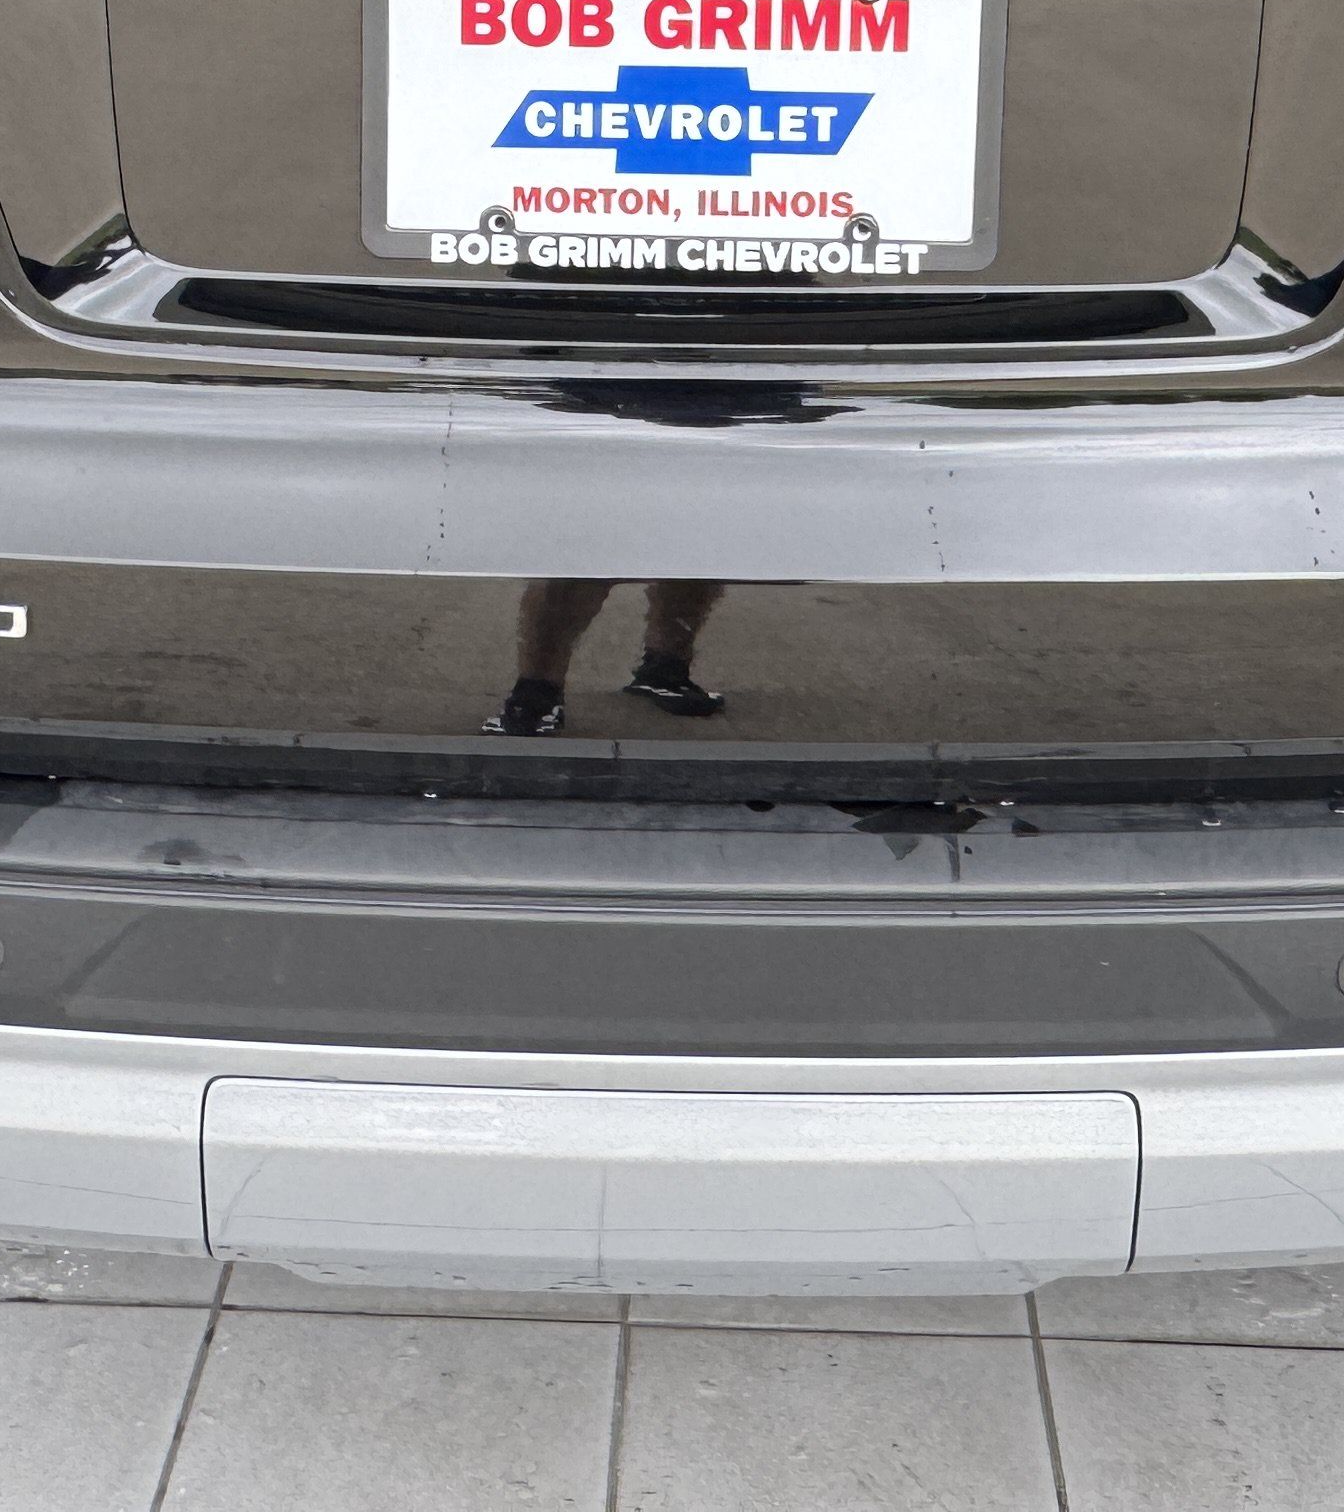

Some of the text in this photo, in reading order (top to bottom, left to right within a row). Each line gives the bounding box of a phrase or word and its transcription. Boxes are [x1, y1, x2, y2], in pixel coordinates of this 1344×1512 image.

[525, 101, 839, 143] CHEVROLET
[513, 186, 854, 222] MORTON, ILLINOIS
[431, 233, 928, 274] BOB GRIMM CHEVROLET
